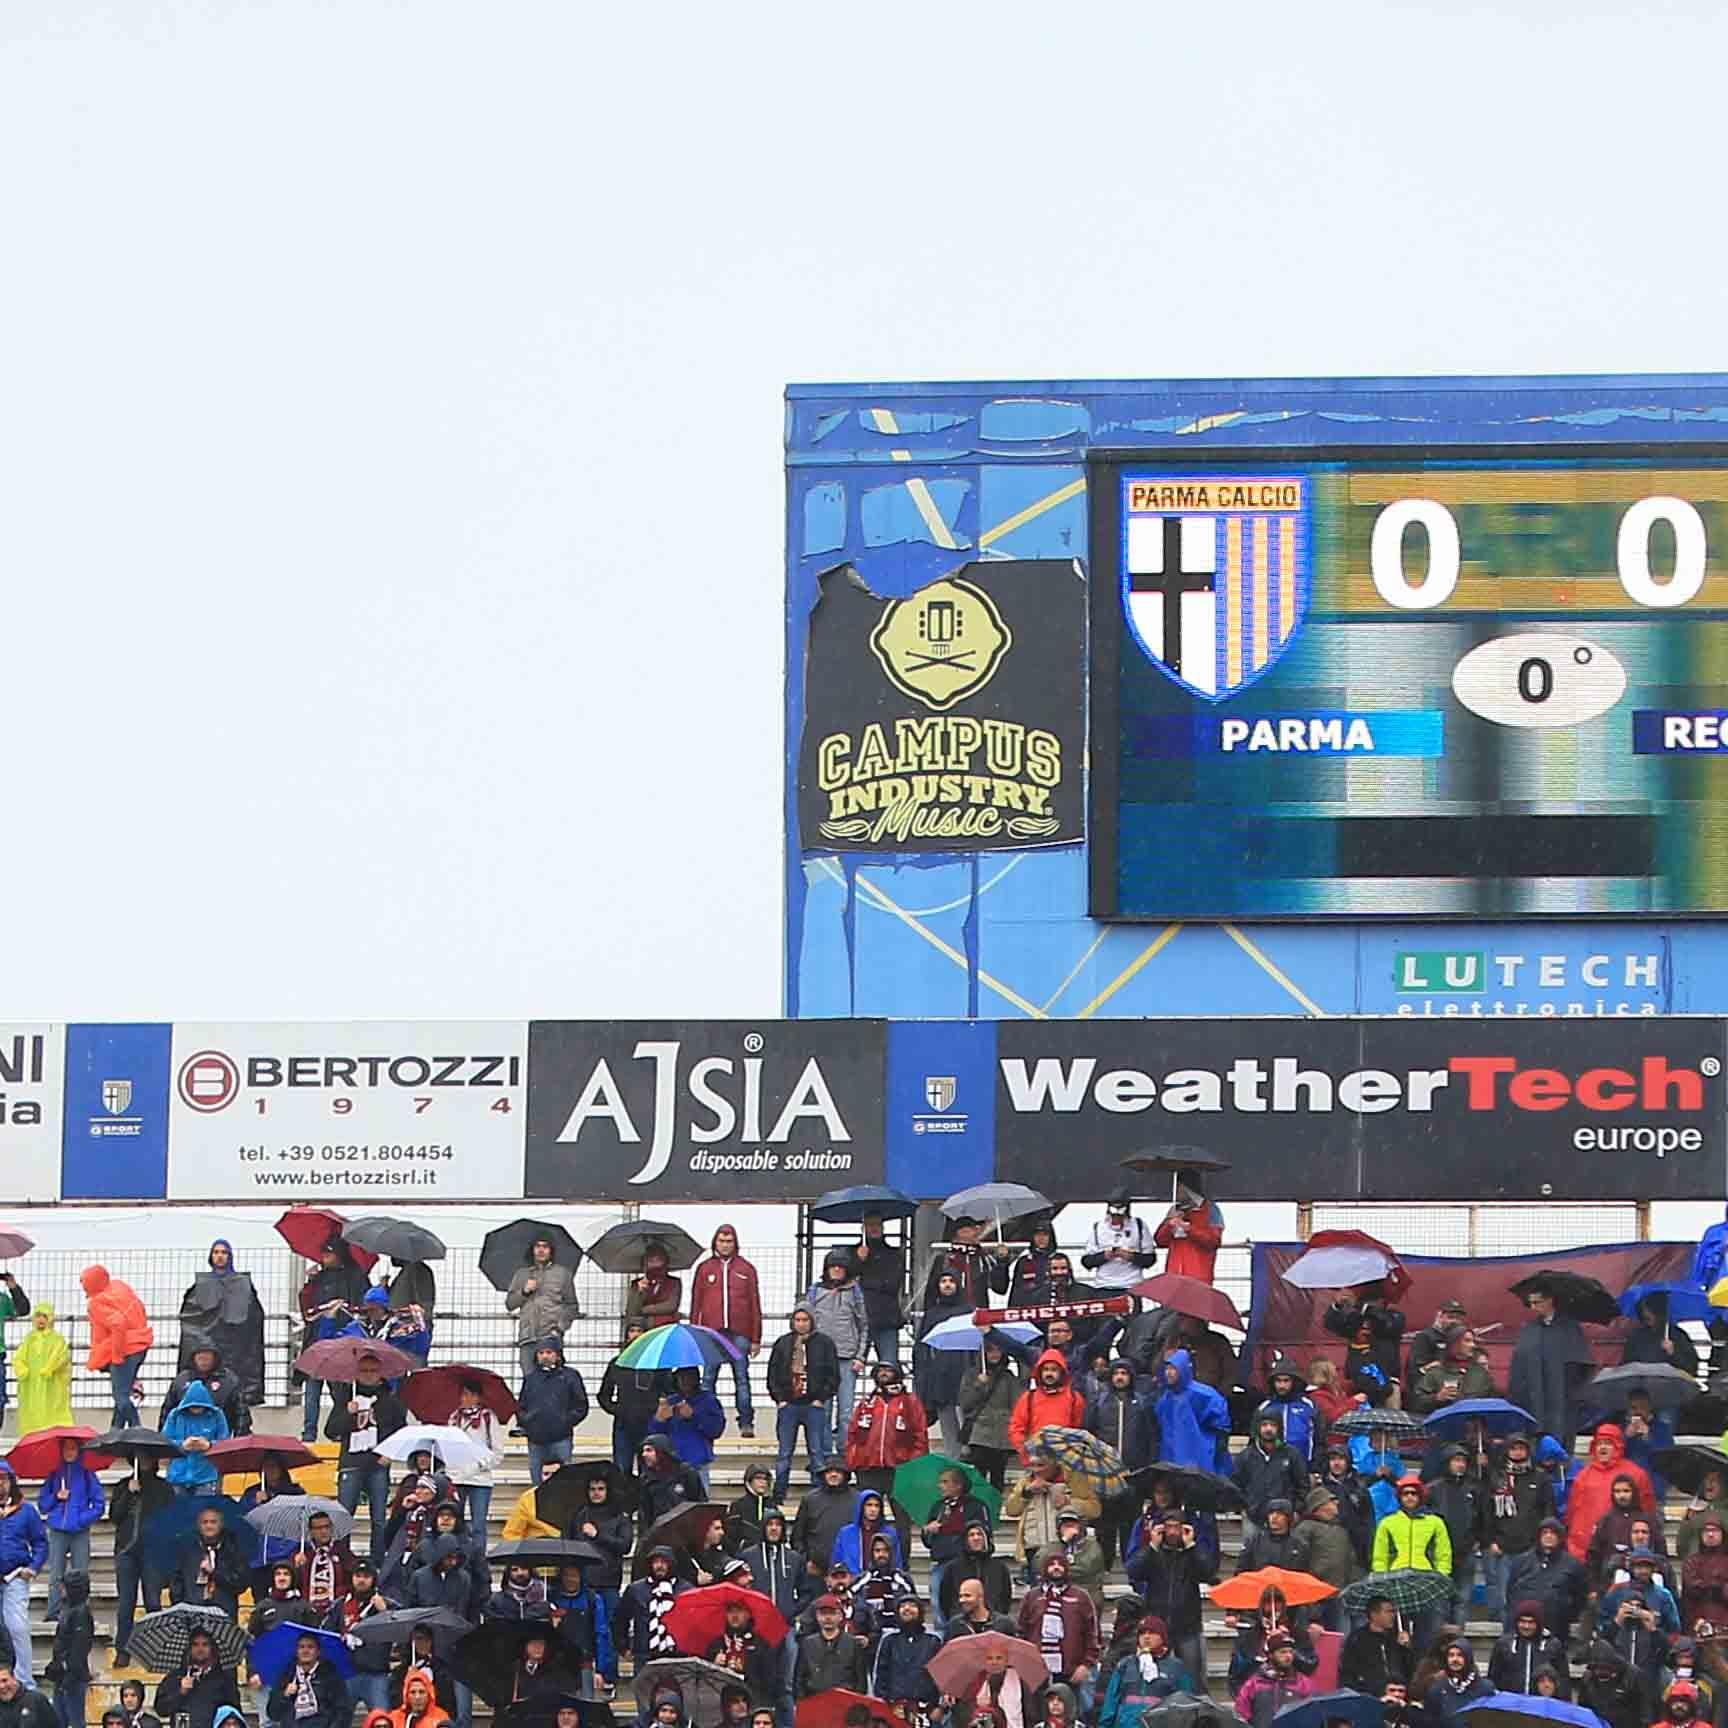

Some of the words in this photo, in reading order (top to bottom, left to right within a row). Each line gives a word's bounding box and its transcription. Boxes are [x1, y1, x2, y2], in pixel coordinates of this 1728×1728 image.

[1132, 486, 1209, 507] PARMA
[1218, 485, 1296, 507] CALCIO
[1371, 499, 1461, 609] 0
[1616, 496, 1706, 608] 0
[1221, 719, 1373, 751] PARMA
[818, 717, 1062, 791] CAMPUS
[829, 775, 1051, 819] INDUSTRY
[872, 800, 1003, 842] Music
[1403, 956, 1658, 987] LUTECH
[1397, 1000, 1656, 1017] elettronica
[247, 1056, 521, 1089] BERTOZZI
[1000, 1055, 1705, 1113] WeatherTech
[238, 1144, 271, 1162] tel.
[278, 1145, 316, 1162] +39
[322, 1144, 455, 1161] 0521.804454
[1573, 1122, 1705, 1153] europe
[688, 1149, 780, 1175] disposable
[783, 1148, 853, 1172] solution
[254, 1167, 438, 1188] www.bertozzisrl.it
[1005, 1303, 1105, 1321] GHETTO
